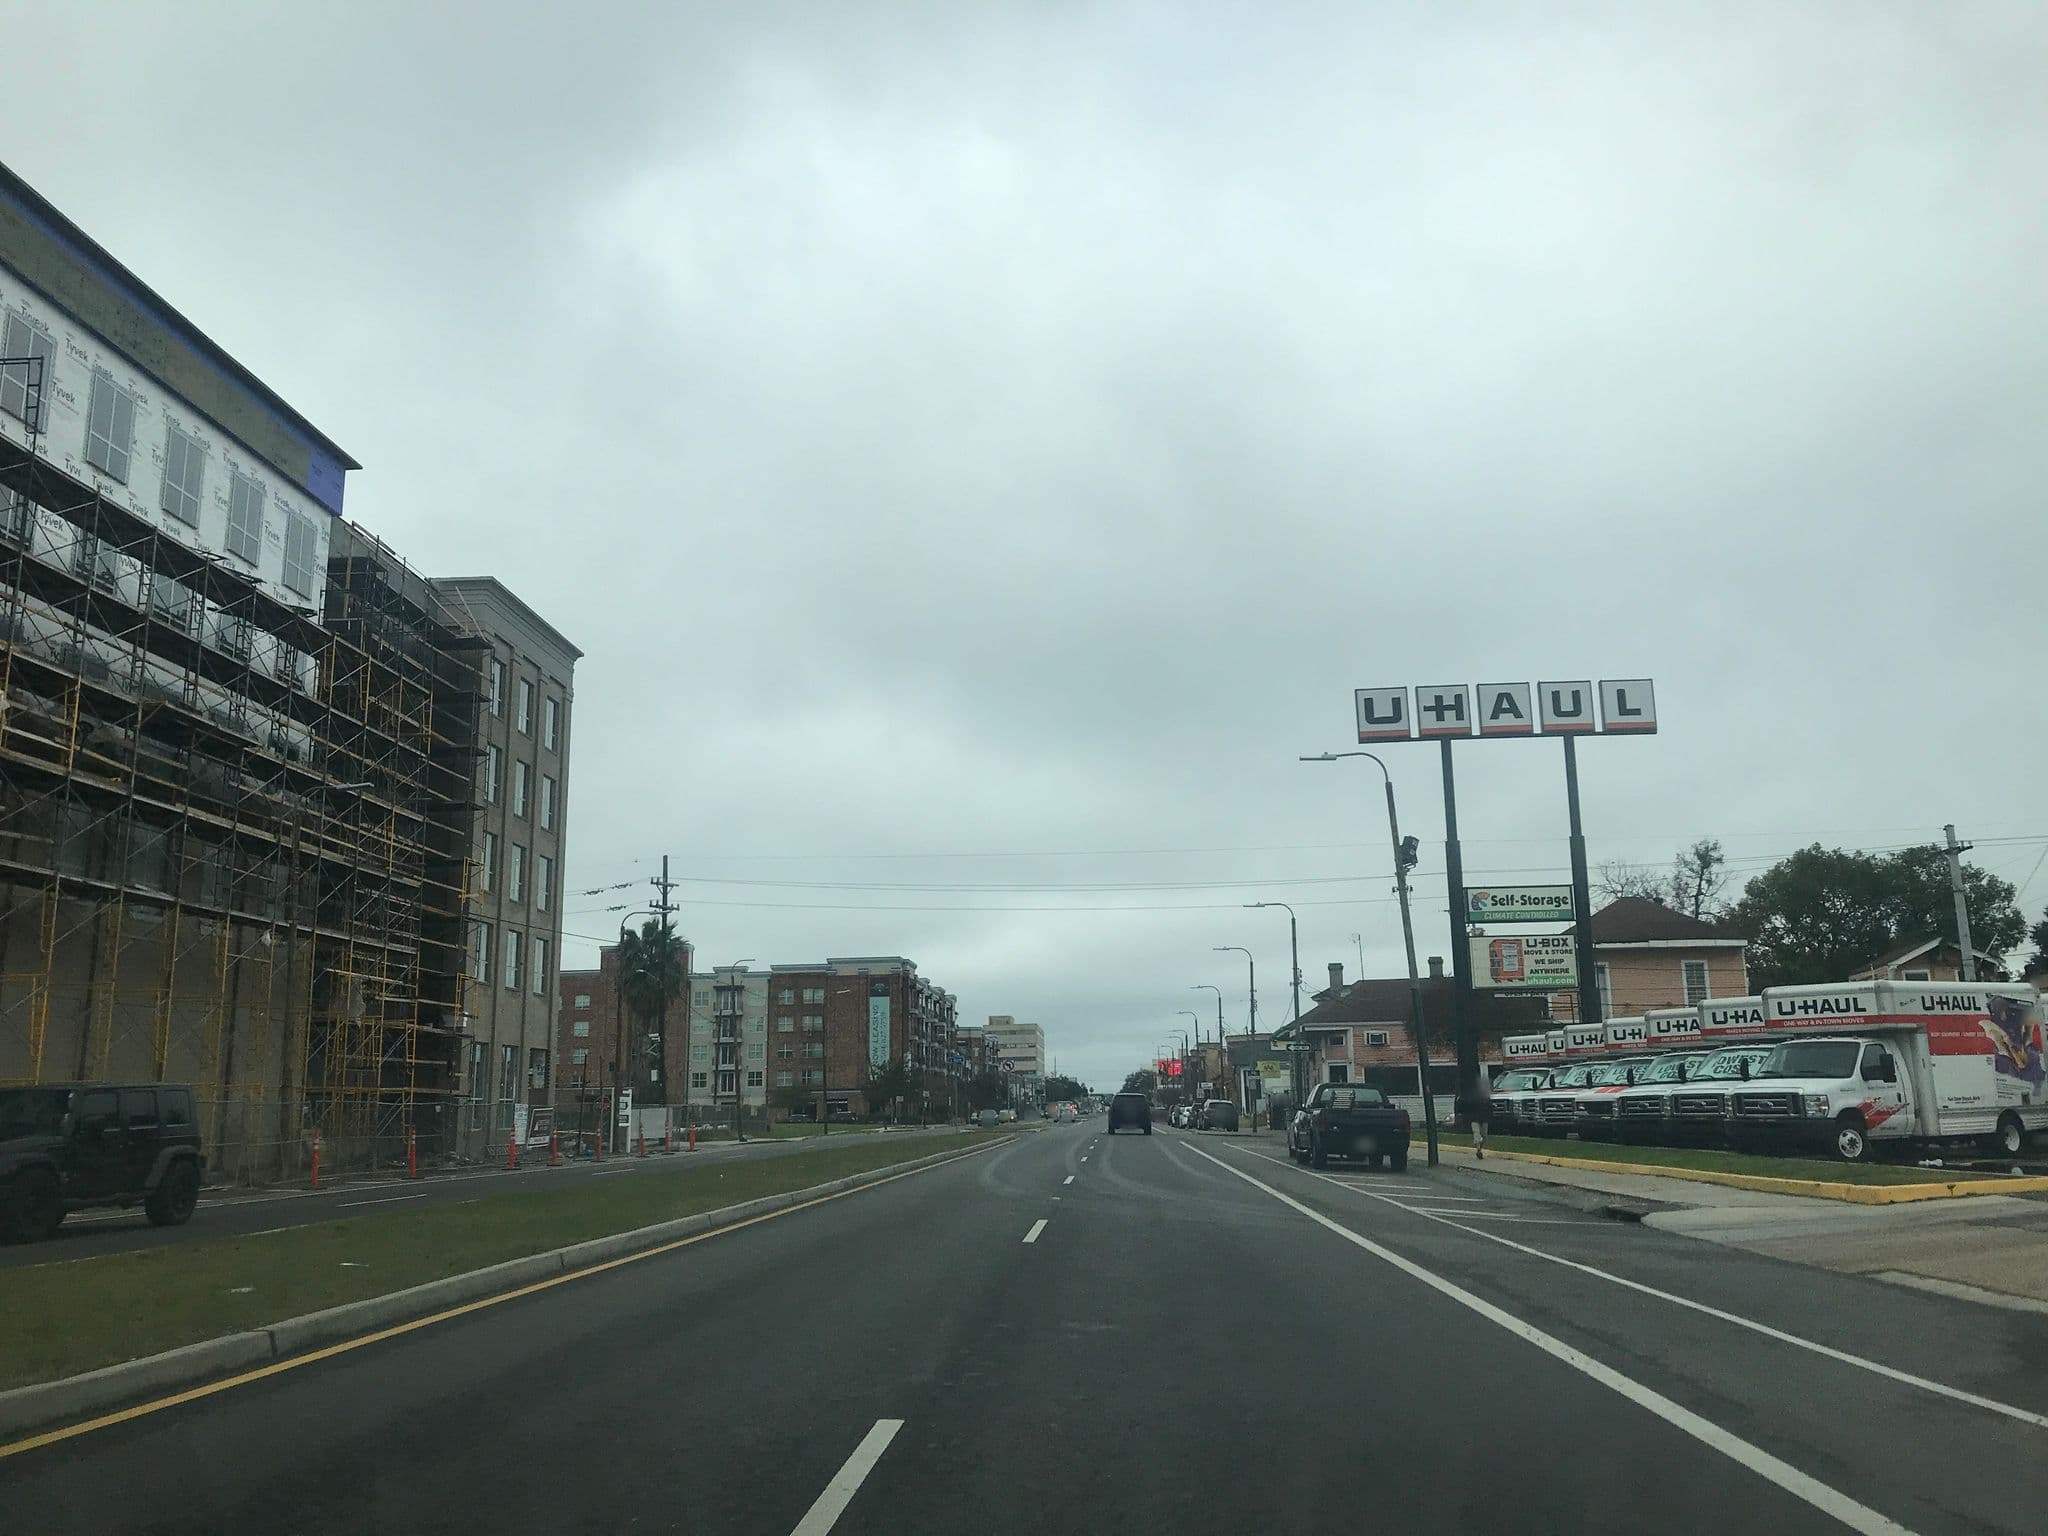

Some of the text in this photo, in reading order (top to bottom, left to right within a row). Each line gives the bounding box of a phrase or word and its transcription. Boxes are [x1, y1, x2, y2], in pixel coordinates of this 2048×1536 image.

[65, 337, 89, 362] Tyvek
[52, 380, 76, 405] Tyvek
[128, 496, 150, 519] Tyvek
[40, 509, 65, 532] Tyvek
[1490, 894, 1569, 908] Self-Storage
[1484, 910, 1559, 920] CLIMATE CONTROLLED
[1526, 937, 1569, 948] U-BOX
[1529, 967, 1570, 975] ANYWHERE
[1527, 977, 1575, 985] uhaul.com
[1776, 997, 1867, 1016] U-HAUL
[1920, 995, 1982, 1011] U-HAUL
